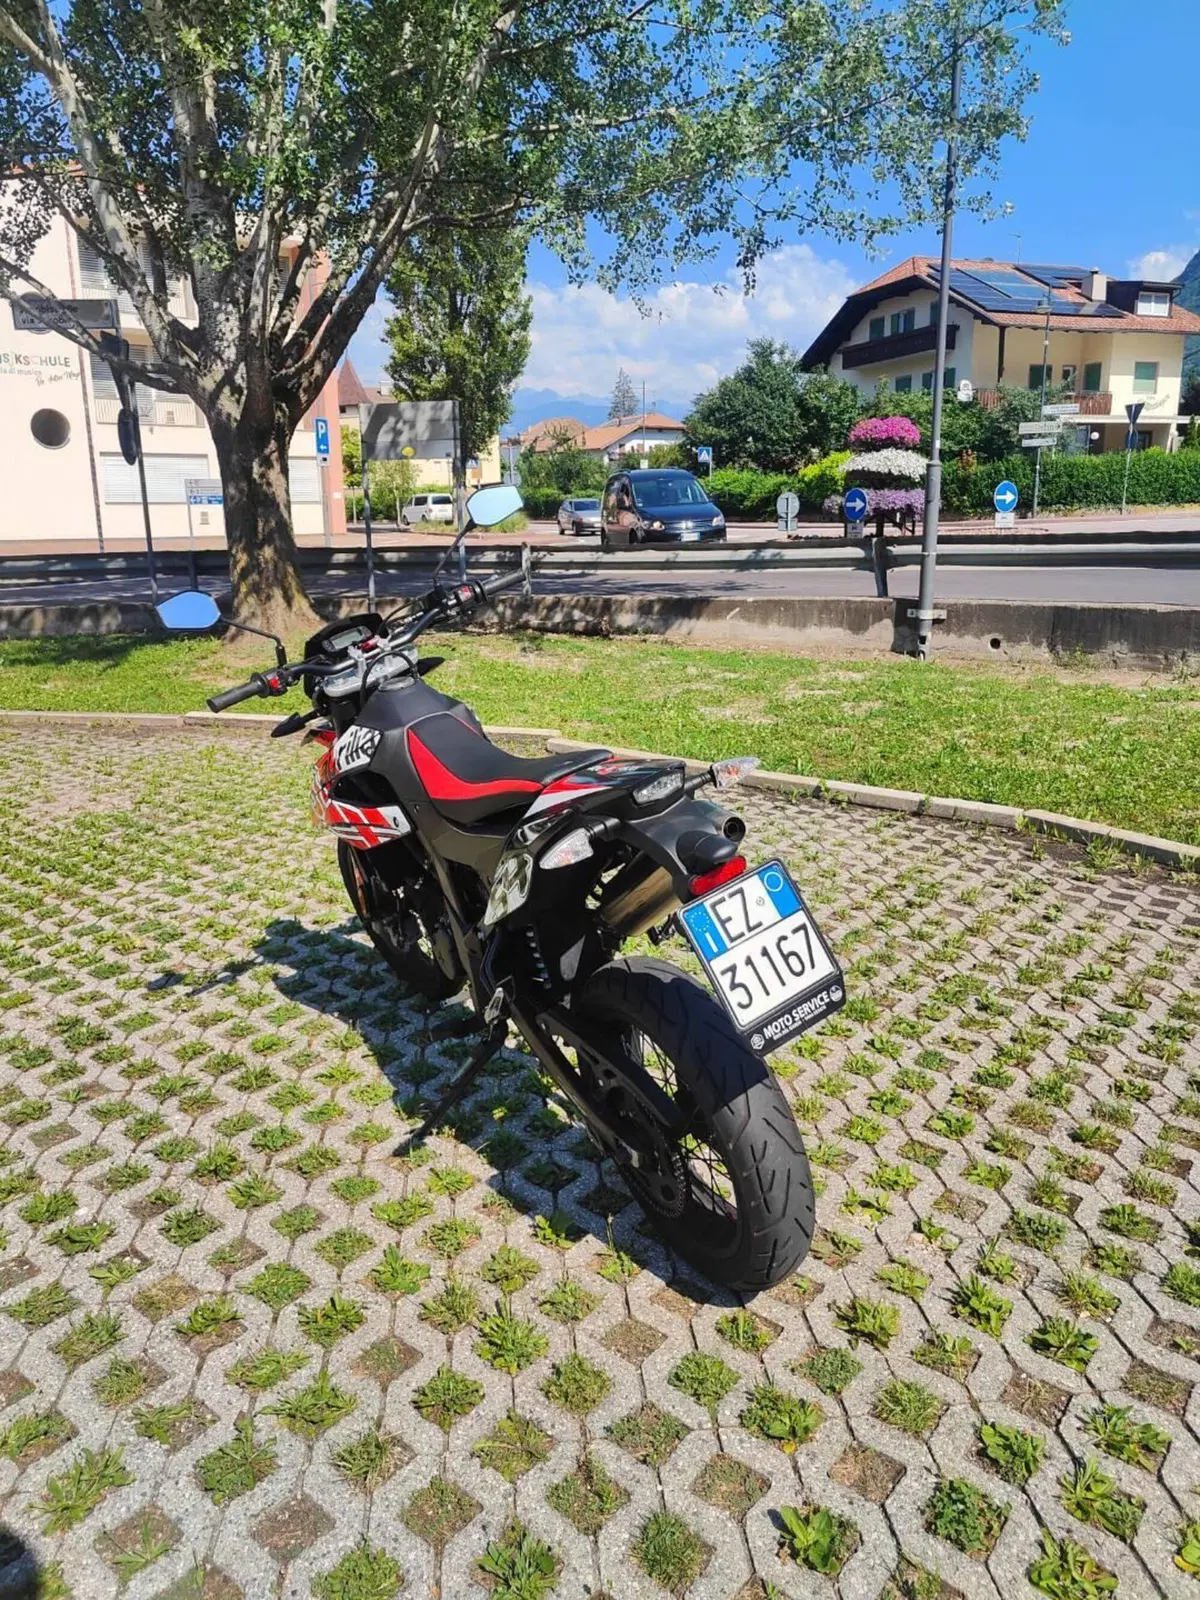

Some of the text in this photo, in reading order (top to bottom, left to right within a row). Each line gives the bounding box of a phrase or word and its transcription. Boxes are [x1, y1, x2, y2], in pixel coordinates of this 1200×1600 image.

[317, 421, 326, 439] P
[709, 886, 763, 944] EZ
[720, 922, 816, 1010] 31167
[763, 1014, 792, 1040] MOTO
[792, 990, 831, 1021] SERVICE
